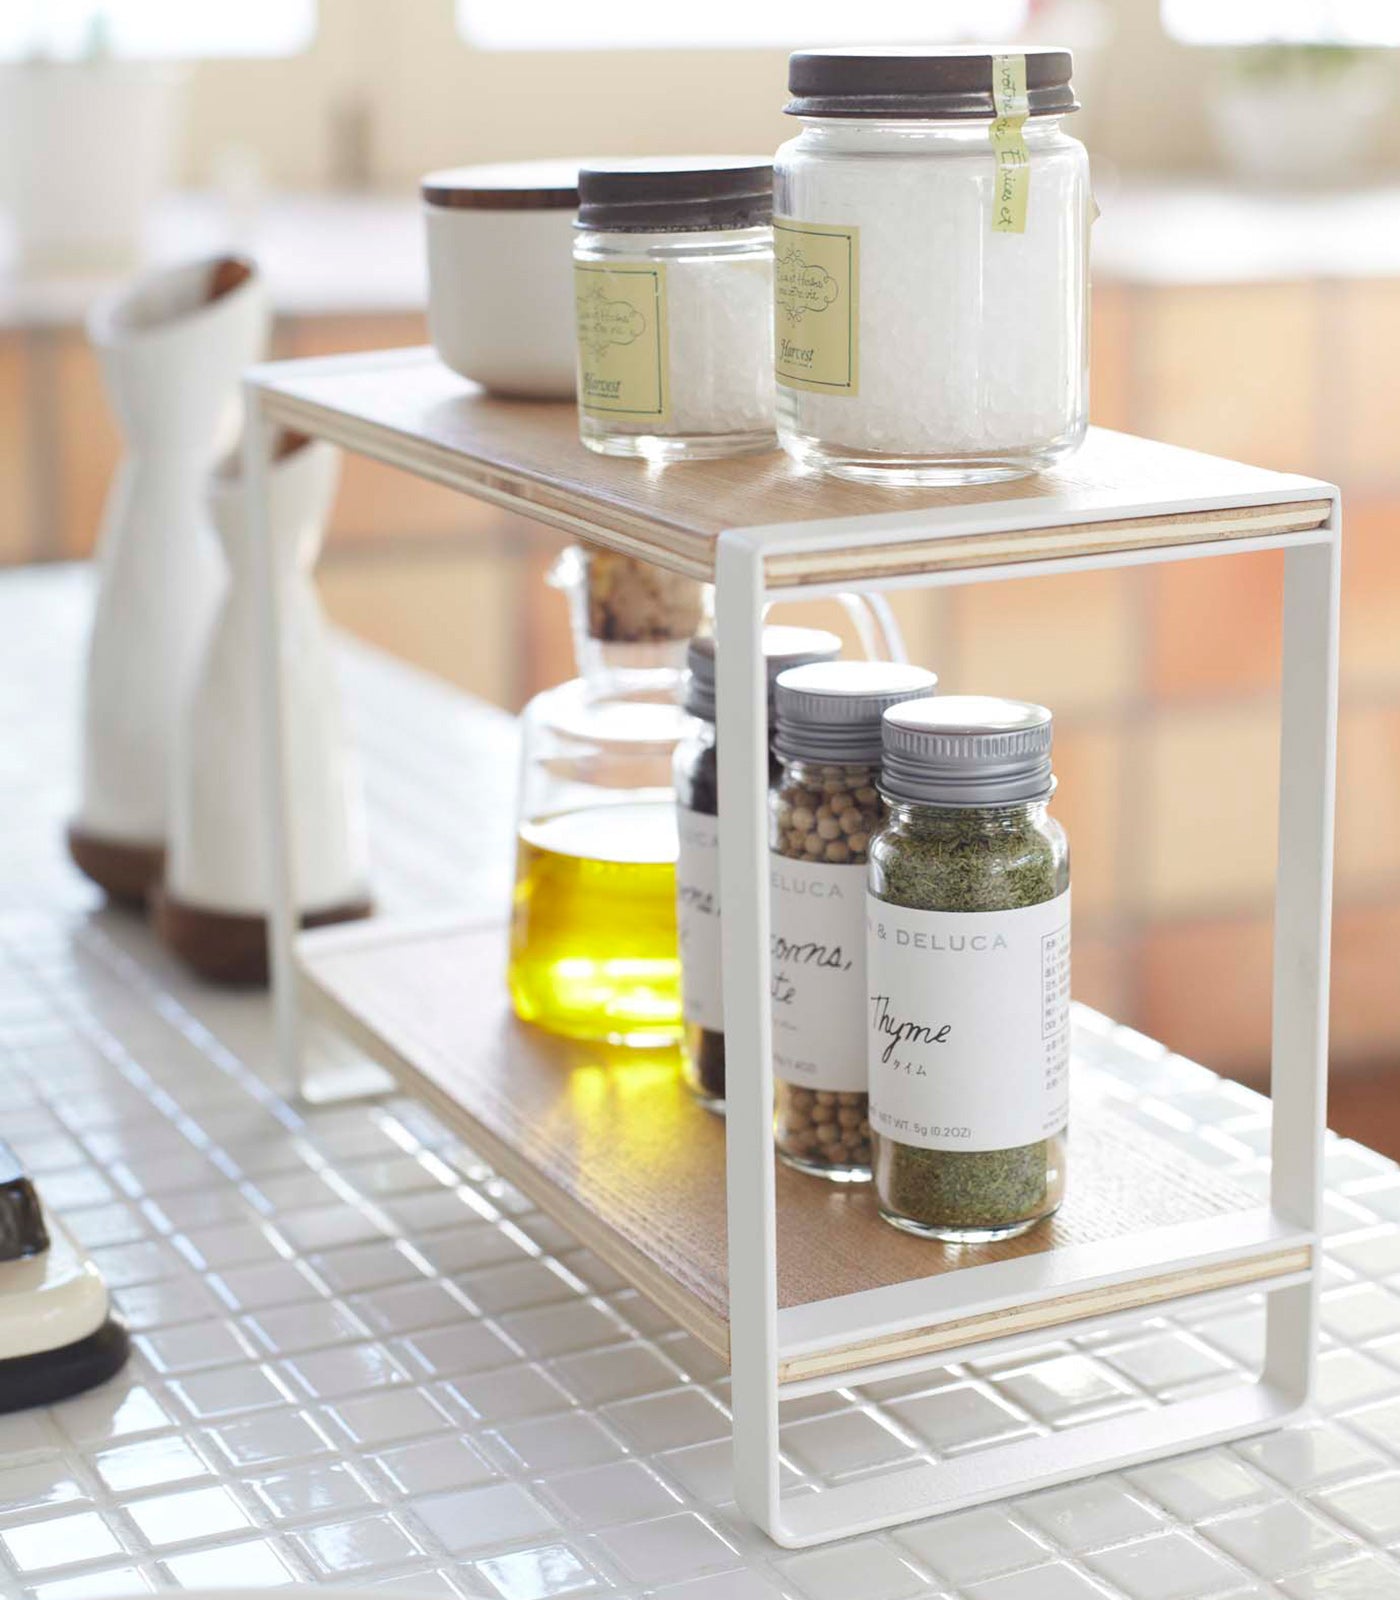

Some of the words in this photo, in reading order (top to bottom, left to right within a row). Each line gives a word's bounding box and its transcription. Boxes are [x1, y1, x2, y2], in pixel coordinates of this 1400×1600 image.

[771, 871, 845, 899] ELUCA
[877, 922, 887, 940] &
[896, 929, 1008, 952] DELUCA
[870, 995, 952, 1064] Thyme
[894, 1118, 911, 1132] WT.
[914, 1123, 929, 1137] 5g
